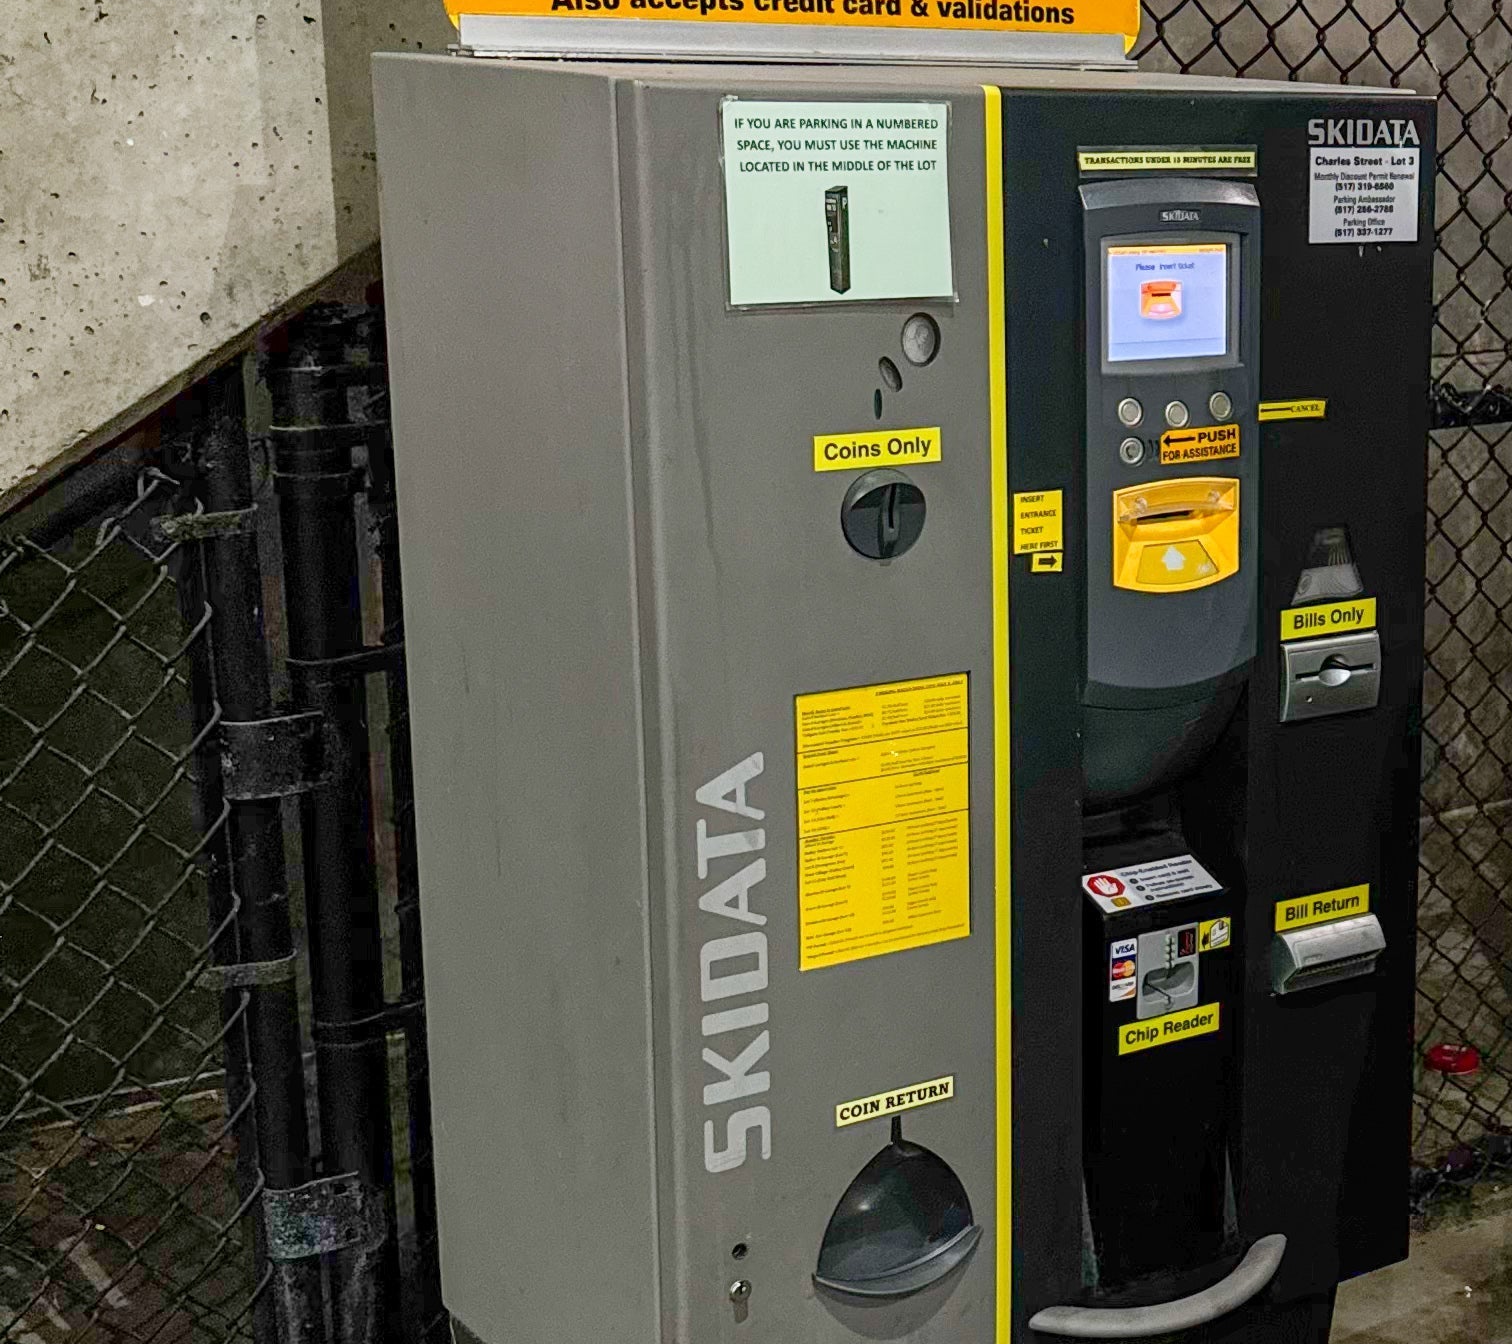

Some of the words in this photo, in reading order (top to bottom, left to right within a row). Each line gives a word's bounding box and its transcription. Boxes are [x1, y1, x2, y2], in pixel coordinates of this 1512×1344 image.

[734, 118, 744, 129] IF
[747, 118, 771, 129] YOU
[774, 118, 796, 129] ARE
[799, 118, 848, 129] PARKING
[851, 118, 862, 129] IN
[865, 118, 874, 129] A
[877, 118, 938, 129] NUMBERED
[1308, 118, 1420, 145] SKIDATA
[737, 140, 774, 152] SPACE,
[777, 140, 801, 150] YOU
[805, 140, 836, 150] MUST
[840, 140, 860, 150] USE
[864, 140, 884, 150] THE
[887, 140, 937, 150] MACHINE
[740, 161, 789, 172] LOCATED
[793, 161, 805, 172] IN
[808, 161, 829, 172] THE
[832, 160, 874, 171] MIDDLE
[877, 160, 891, 171] OF
[894, 160, 915, 171] THE
[918, 160, 937, 170] LOT
[1146, 156, 1171, 164] UNDER
[1218, 156, 1232, 164] ARE
[1315, 156, 1351, 166] Charles
[1354, 156, 1382, 166] Street
[1391, 156, 1406, 166] Lot
[1409, 156, 1415, 166] 3
[1334, 195, 1356, 205] Parking
[1161, 210, 1200, 222] SKIDATA
[1343, 218, 1366, 228] Parking
[1198, 428, 1236, 443] PUSH
[824, 442, 881, 461] Coins
[888, 437, 932, 457] Only
[1163, 450, 1181, 461] FOR
[1183, 443, 1237, 459] ASSISTANCE
[1020, 495, 1044, 503] INSERT
[1020, 509, 1057, 519] ENTRANCE
[1020, 526, 1044, 535] TICKET
[1020, 542, 1038, 551] HERE
[1040, 541, 1058, 549] FIRST
[1294, 613, 1326, 630] Bills
[1330, 607, 1364, 625] Only
[1286, 903, 1308, 922] Bill
[1313, 896, 1360, 916] Return
[1116, 943, 1135, 955] VISA
[696, 751, 771, 1173] SKIDATA
[1126, 1027, 1159, 1044] Chip
[1163, 1013, 1214, 1035] Reader
[840, 1099, 880, 1120] COIN
[885, 1082, 949, 1109] RETURN
